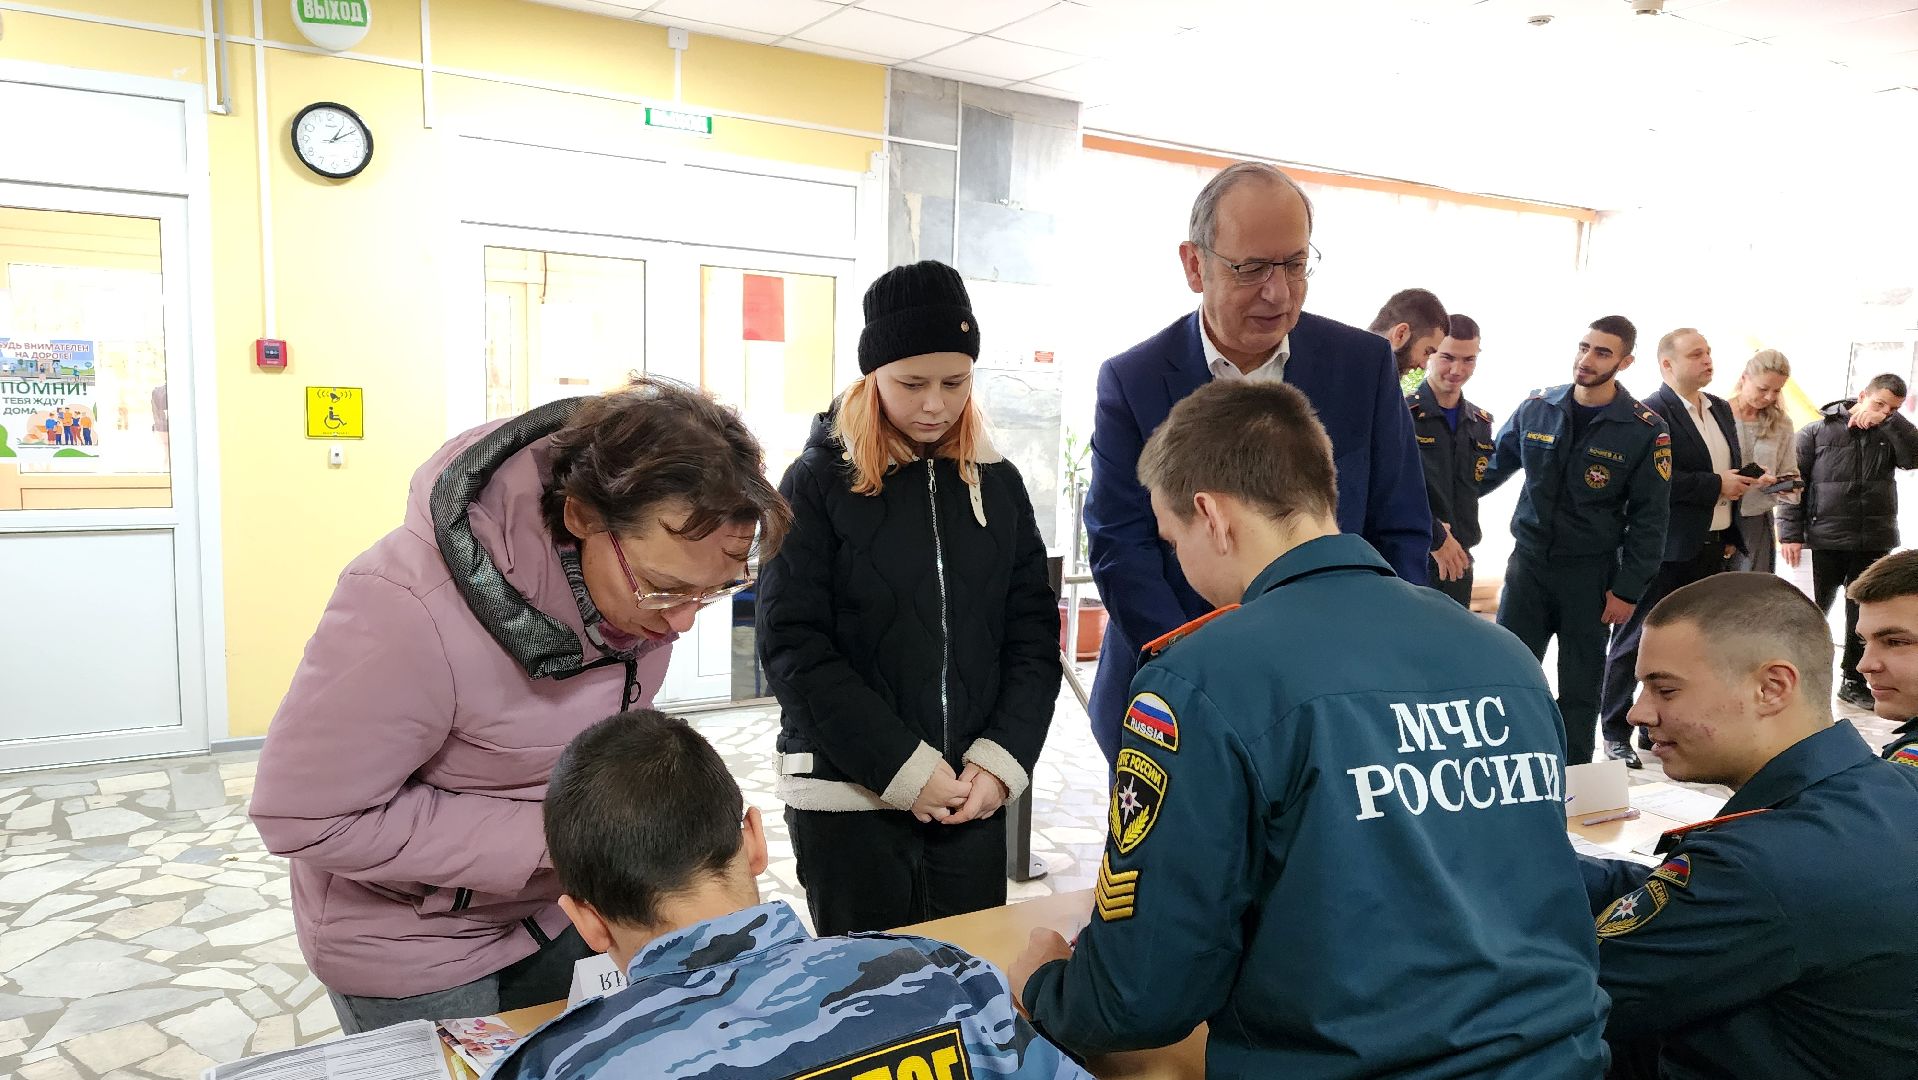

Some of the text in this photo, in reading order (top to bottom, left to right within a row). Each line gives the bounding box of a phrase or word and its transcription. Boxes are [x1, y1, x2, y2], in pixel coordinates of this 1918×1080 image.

[303, 0, 364, 22] ВЫХОД
[24, 343, 89, 352] ВНИМАТЕЛЕН
[31, 352, 72, 360] ДОРОГЕ!
[2, 382, 87, 396] ПОМНИ!
[3, 397, 65, 406] ТЕБЯ ЖДУТ
[3, 407, 38, 416] ДОМА
[1130, 717, 1165, 743] RUSSIA
[1390, 696, 1509, 753] МЧС
[1130, 755, 1162, 788] РОССИИ
[1347, 753, 1561, 821] РОССИИ
